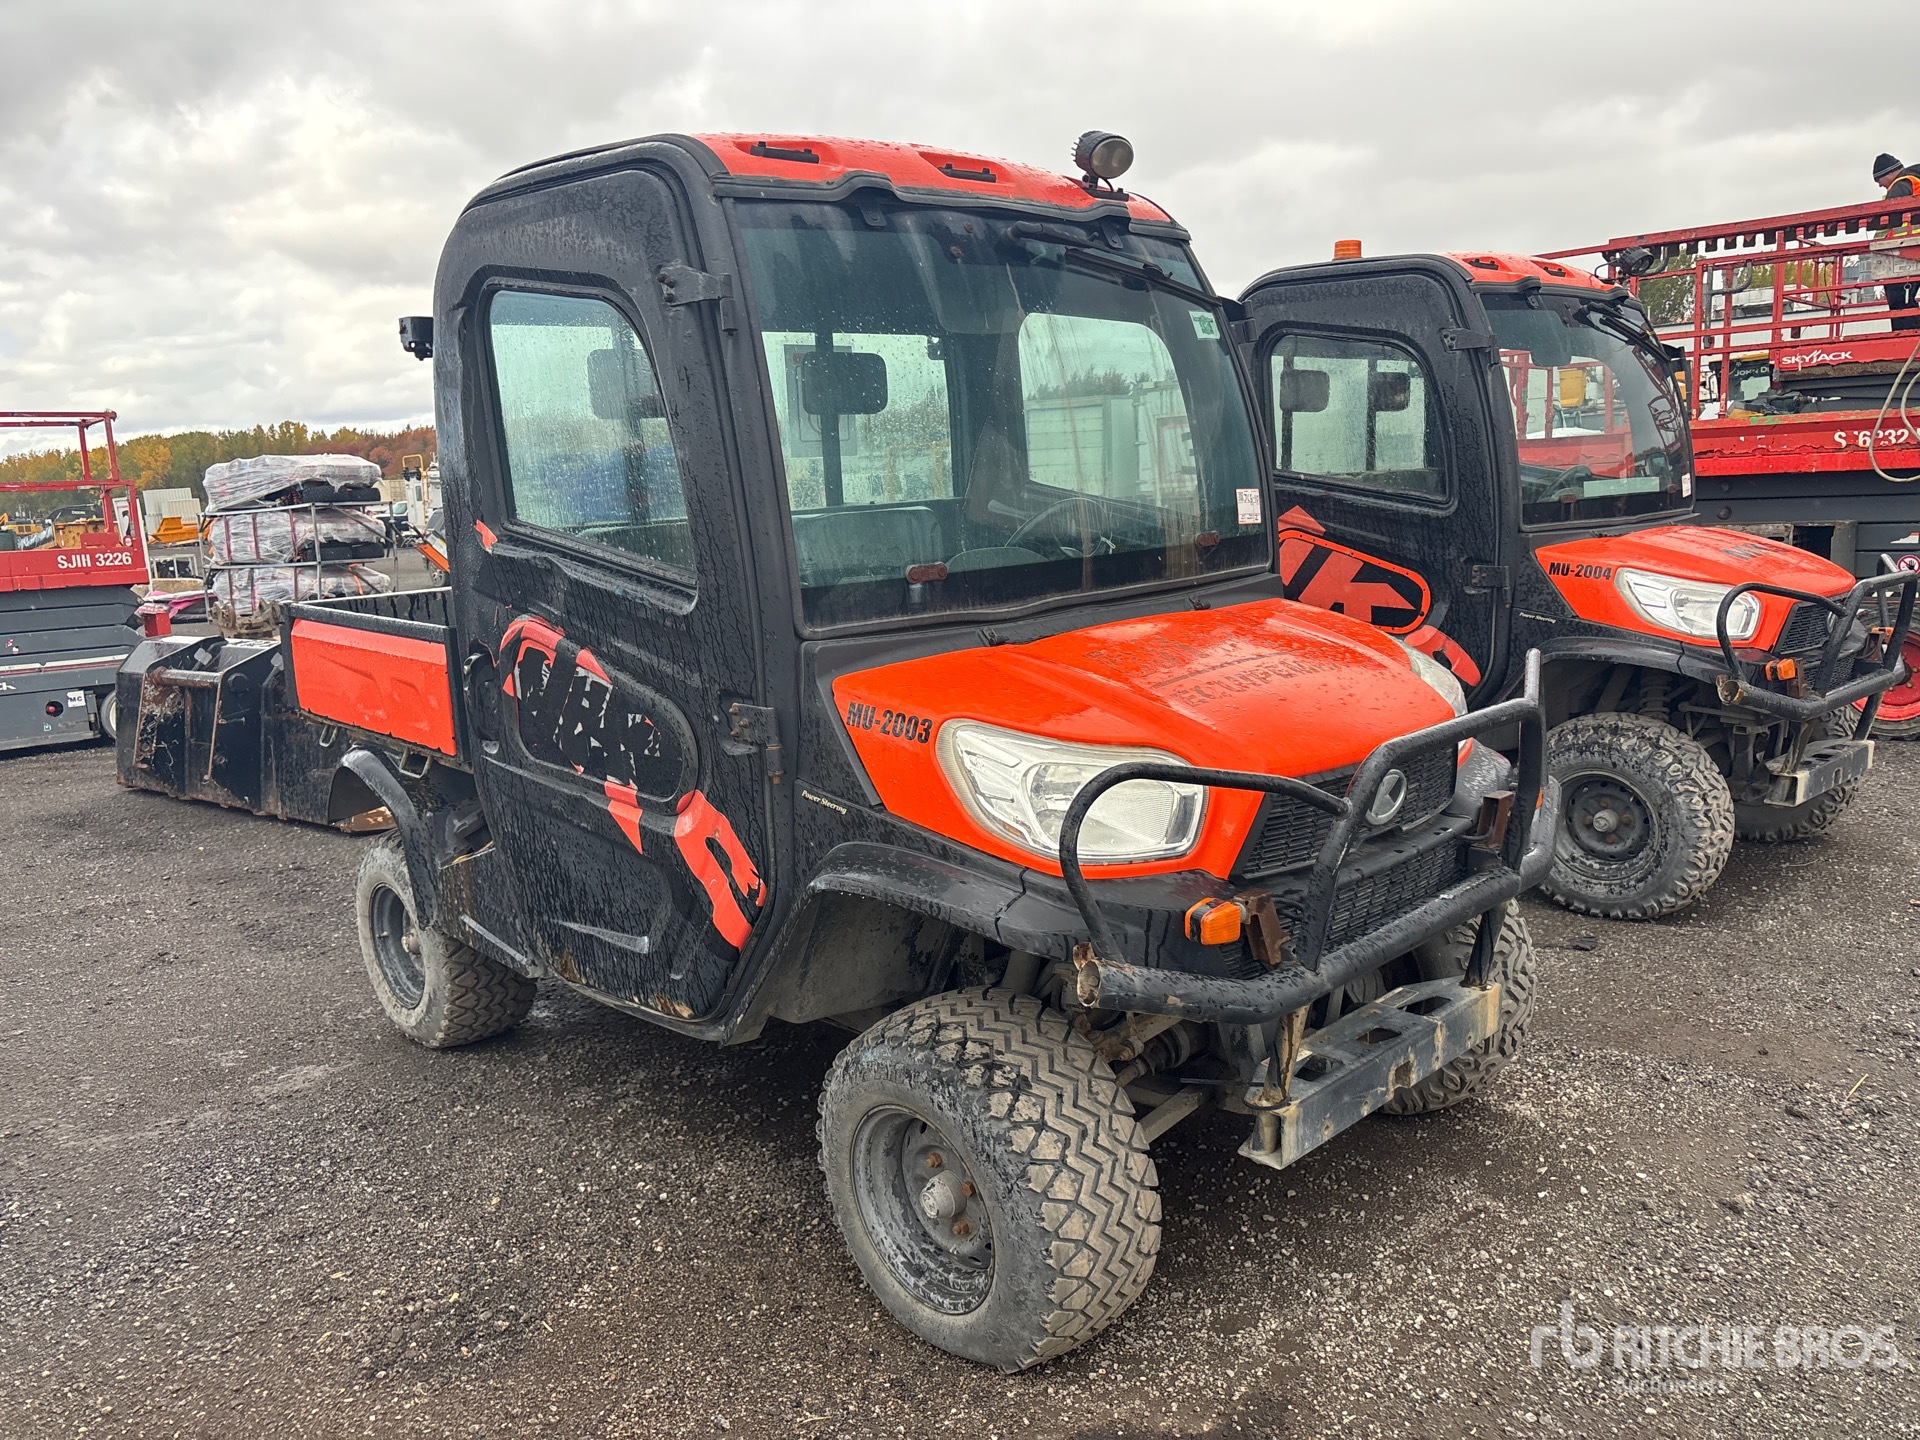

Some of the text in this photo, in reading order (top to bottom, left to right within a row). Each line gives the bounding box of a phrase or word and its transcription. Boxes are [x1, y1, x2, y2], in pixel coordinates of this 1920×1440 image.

[1782, 350, 1853, 365] SKYJACK
[95, 551, 132, 567] 3226
[1548, 562, 1612, 580] MU-2004
[1535, 615, 1557, 624] Steering
[846, 702, 933, 744] MU-2003
[801, 789, 847, 815] Power Steering
